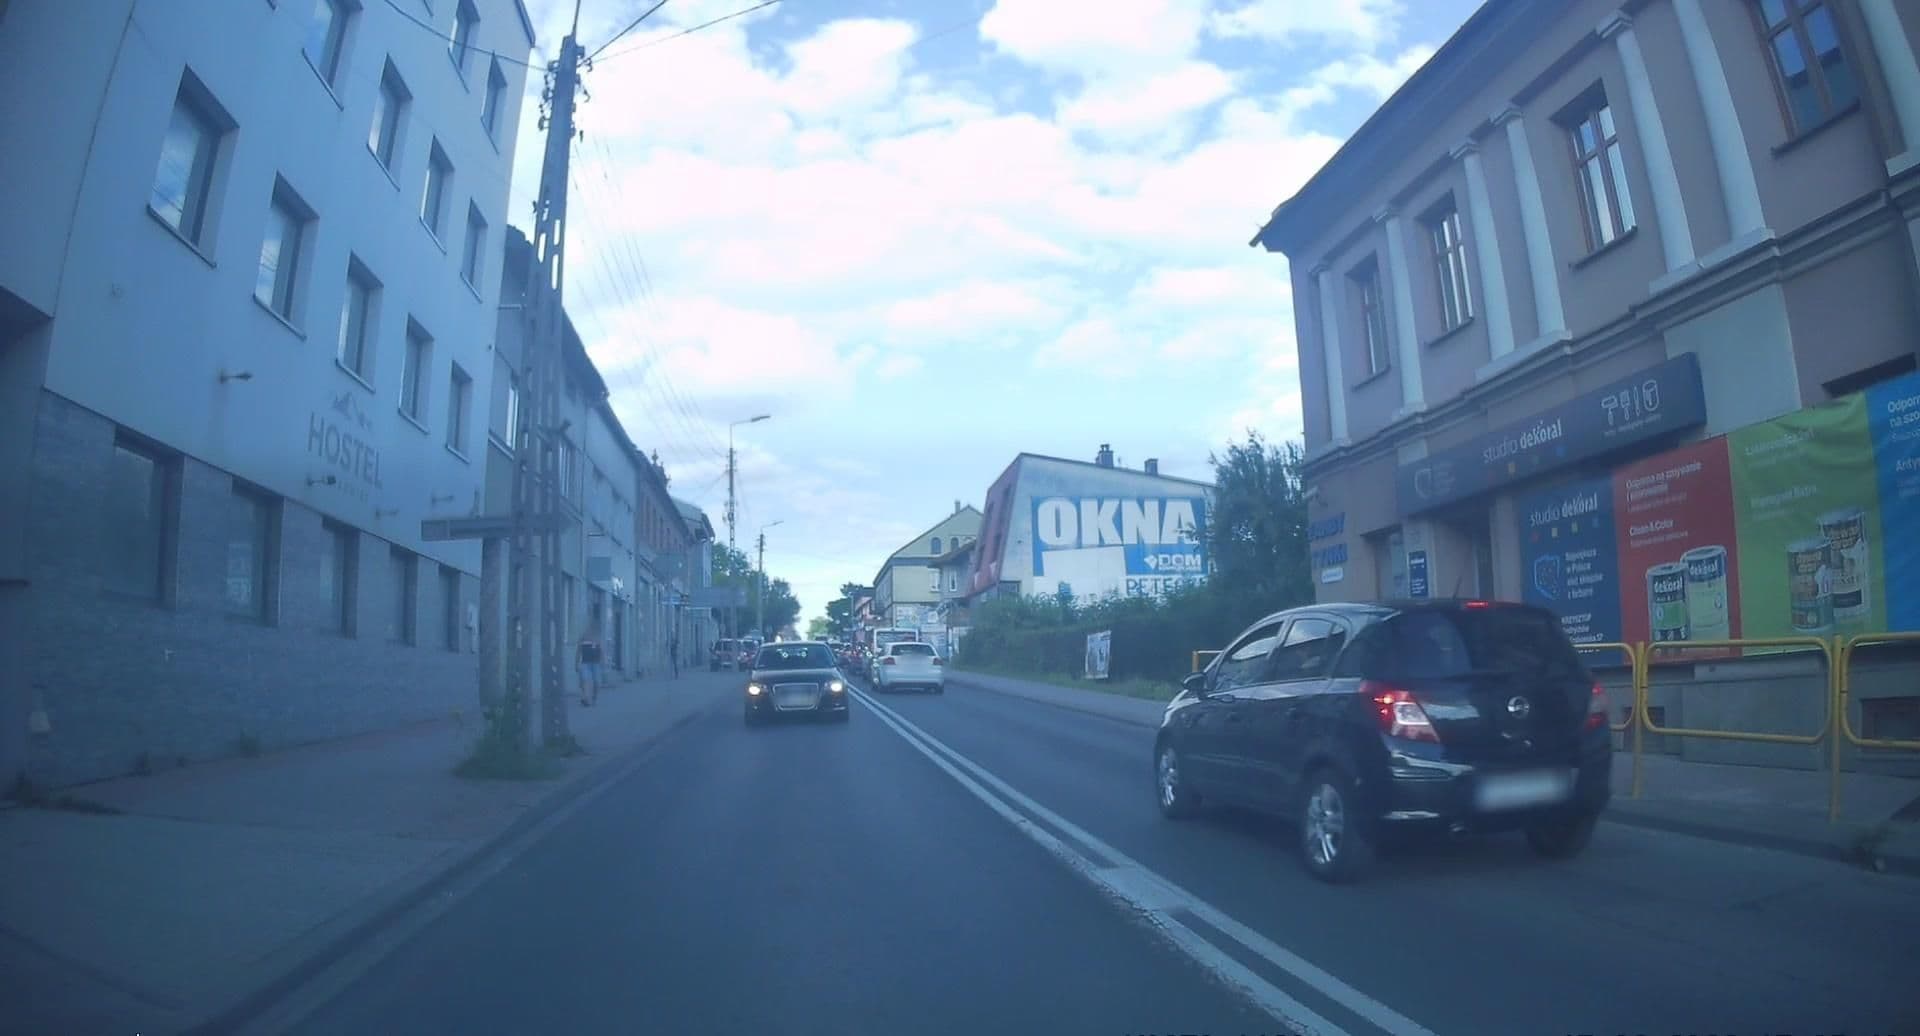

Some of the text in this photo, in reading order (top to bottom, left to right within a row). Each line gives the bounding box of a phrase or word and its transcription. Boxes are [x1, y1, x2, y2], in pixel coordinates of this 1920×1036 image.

[308, 411, 383, 489] HOSTEL
[1482, 416, 1562, 465] studio dekoral
[1037, 497, 1201, 546] OKNA
[1529, 492, 1598, 528] studio dekoral
[1158, 553, 1202, 567] DOM
